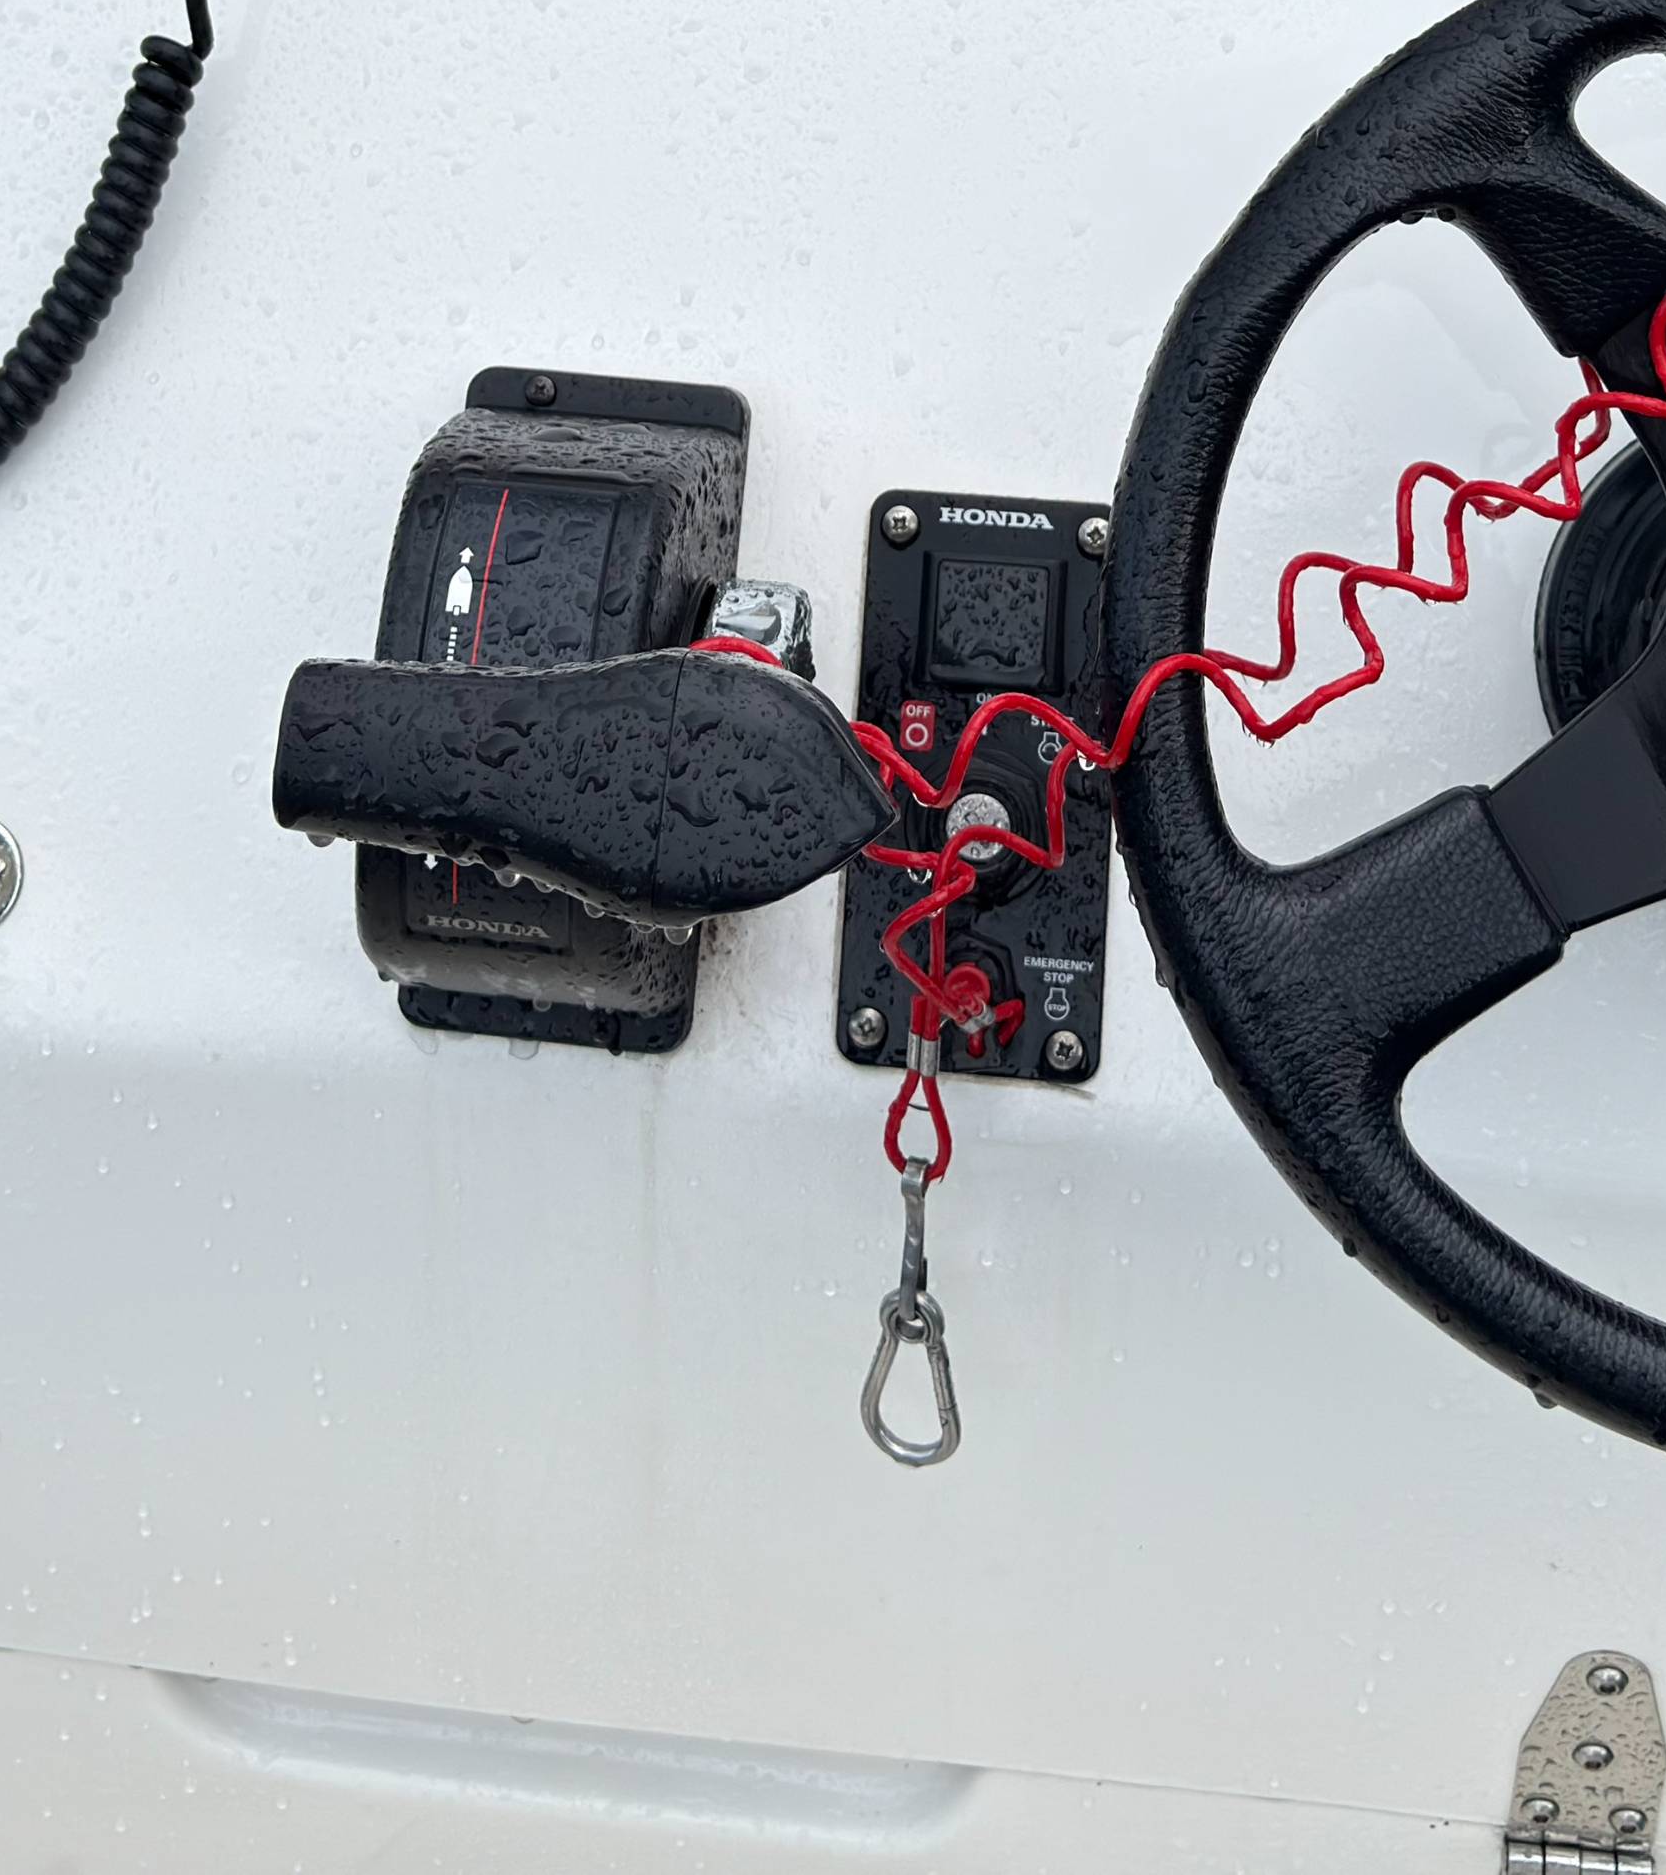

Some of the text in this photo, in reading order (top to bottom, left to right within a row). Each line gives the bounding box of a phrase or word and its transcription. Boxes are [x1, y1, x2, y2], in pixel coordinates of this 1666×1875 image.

[939, 506, 1054, 530] HONDA
[906, 705, 931, 717] OFF
[426, 914, 550, 939] HONDA
[1024, 957, 1094, 971] EMERGENCY
[1043, 972, 1074, 983] STOP
